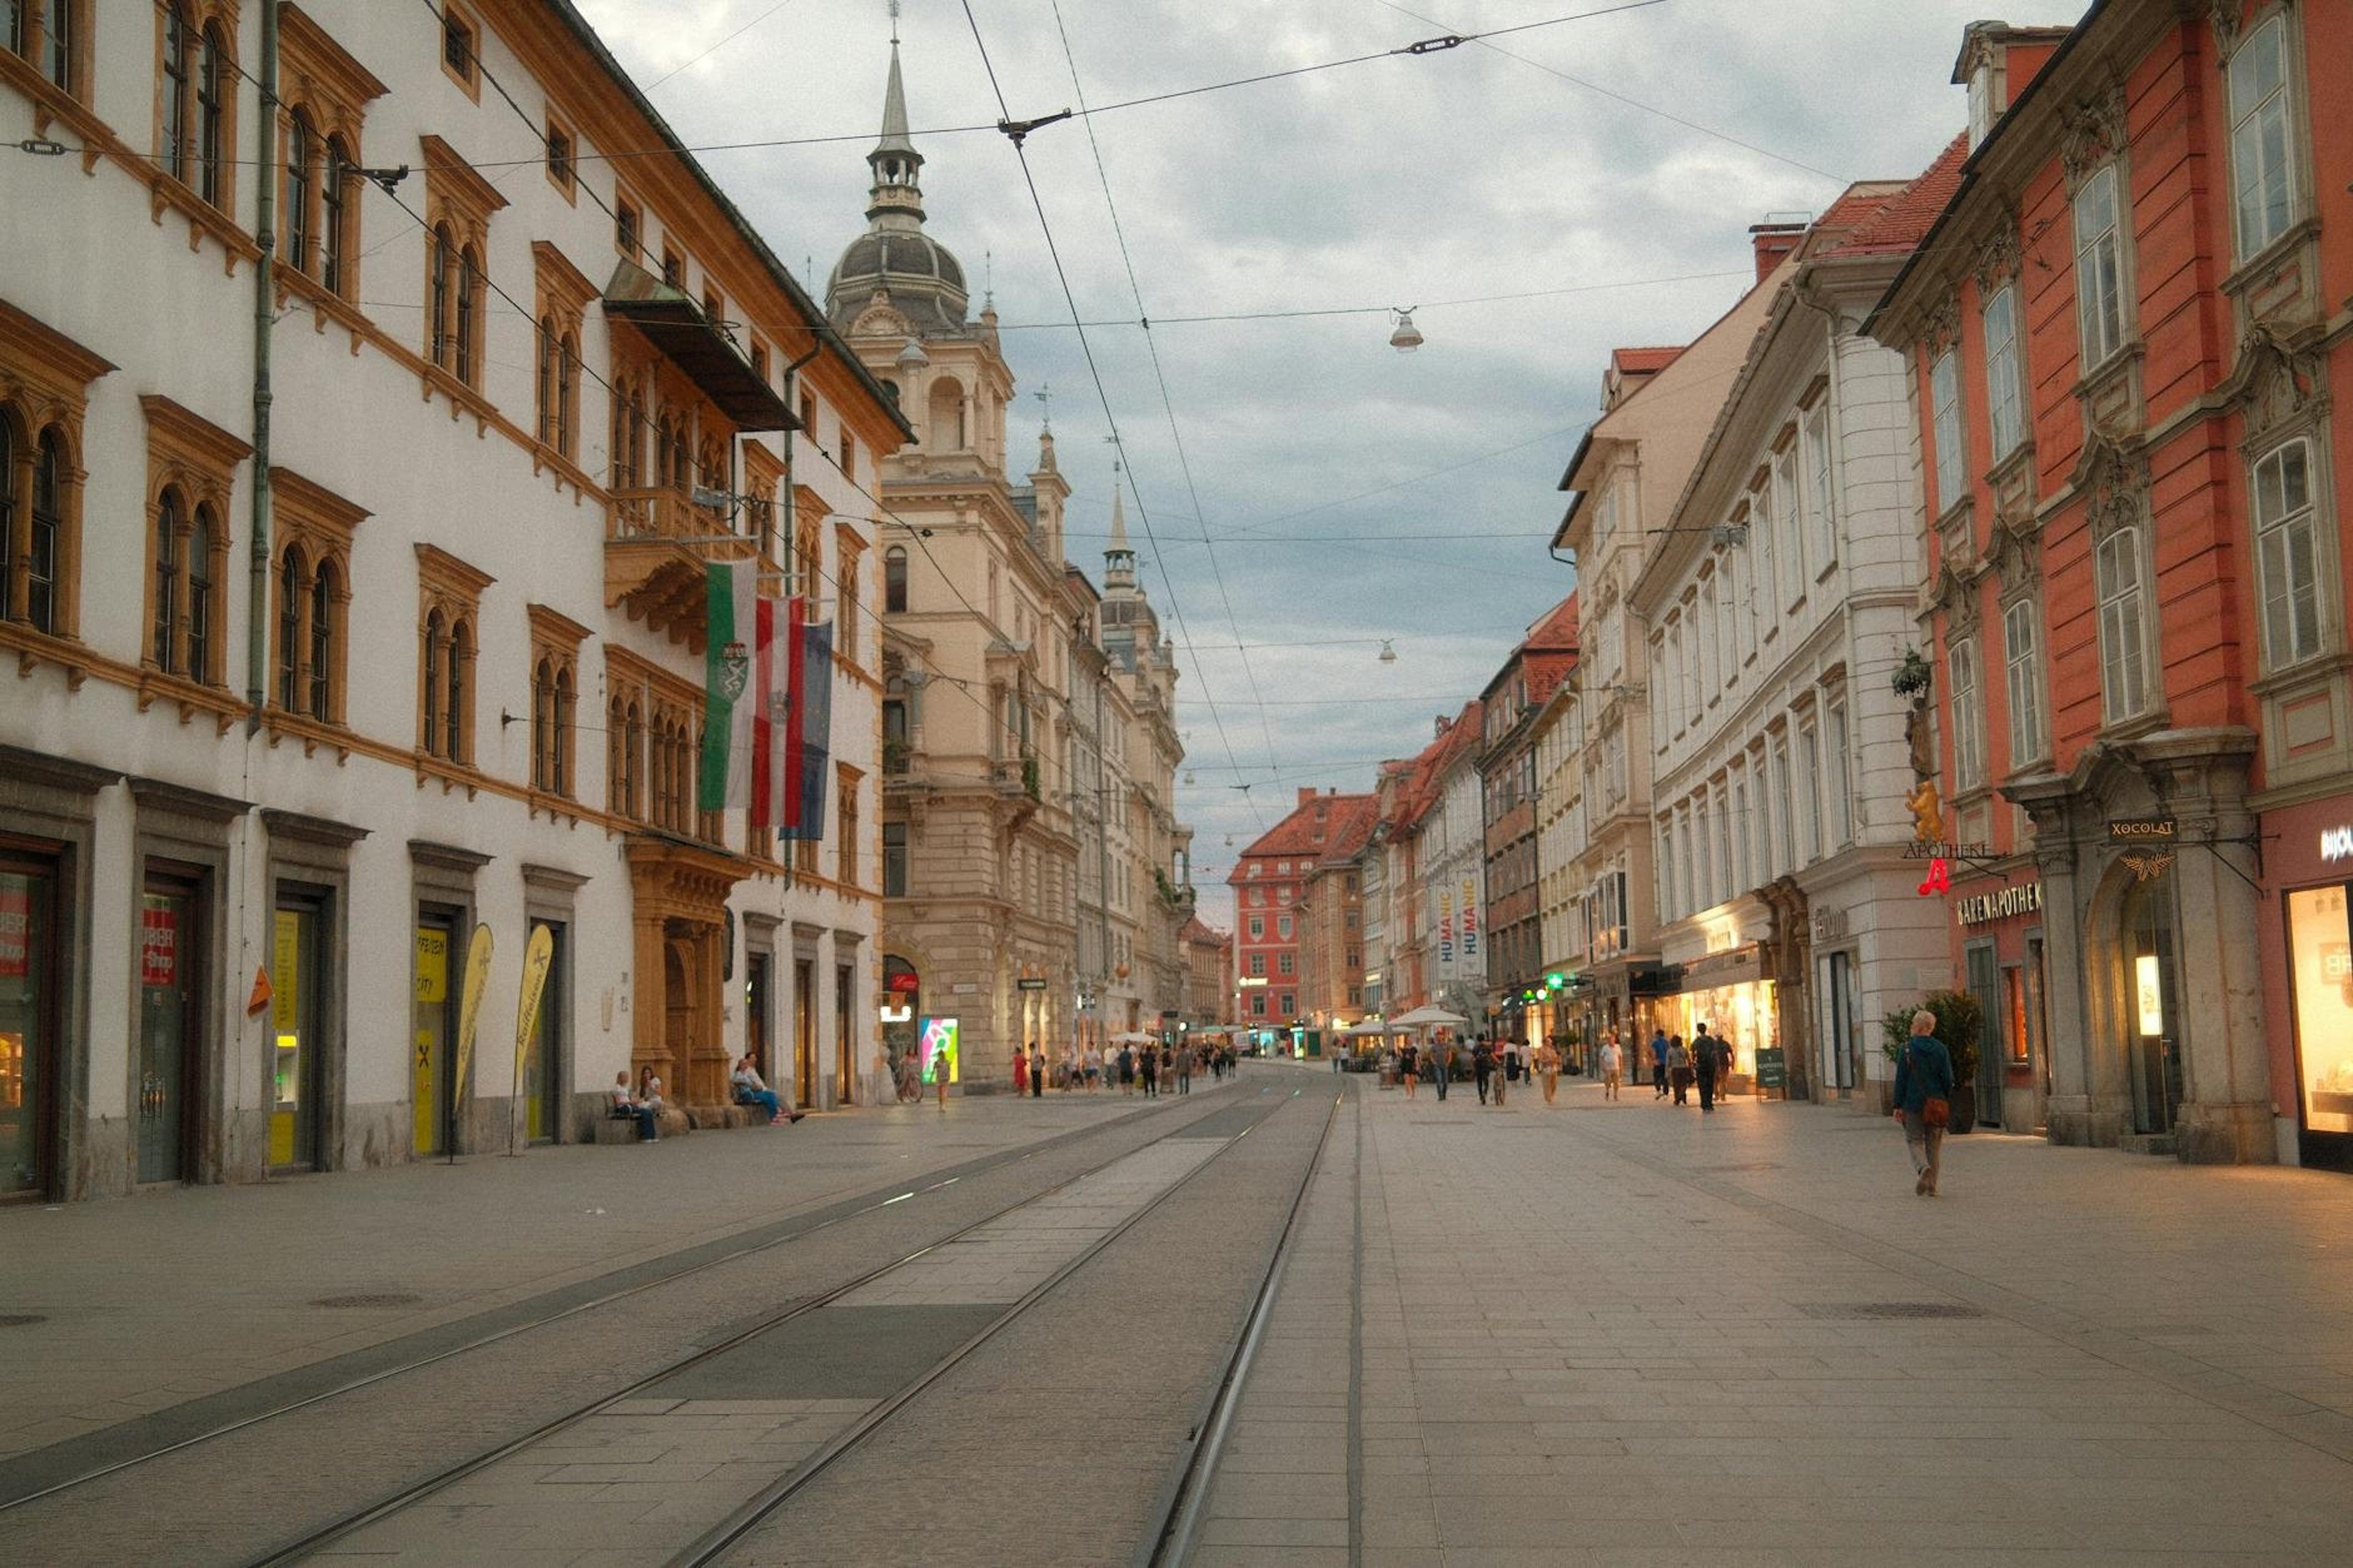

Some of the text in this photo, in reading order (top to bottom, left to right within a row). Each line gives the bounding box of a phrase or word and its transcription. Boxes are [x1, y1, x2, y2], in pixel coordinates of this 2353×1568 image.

[2112, 822, 2173, 835] XOCOLAT
[1441, 893, 1453, 961] HUMANIC
[1463, 879, 1477, 955] HUMANIC
